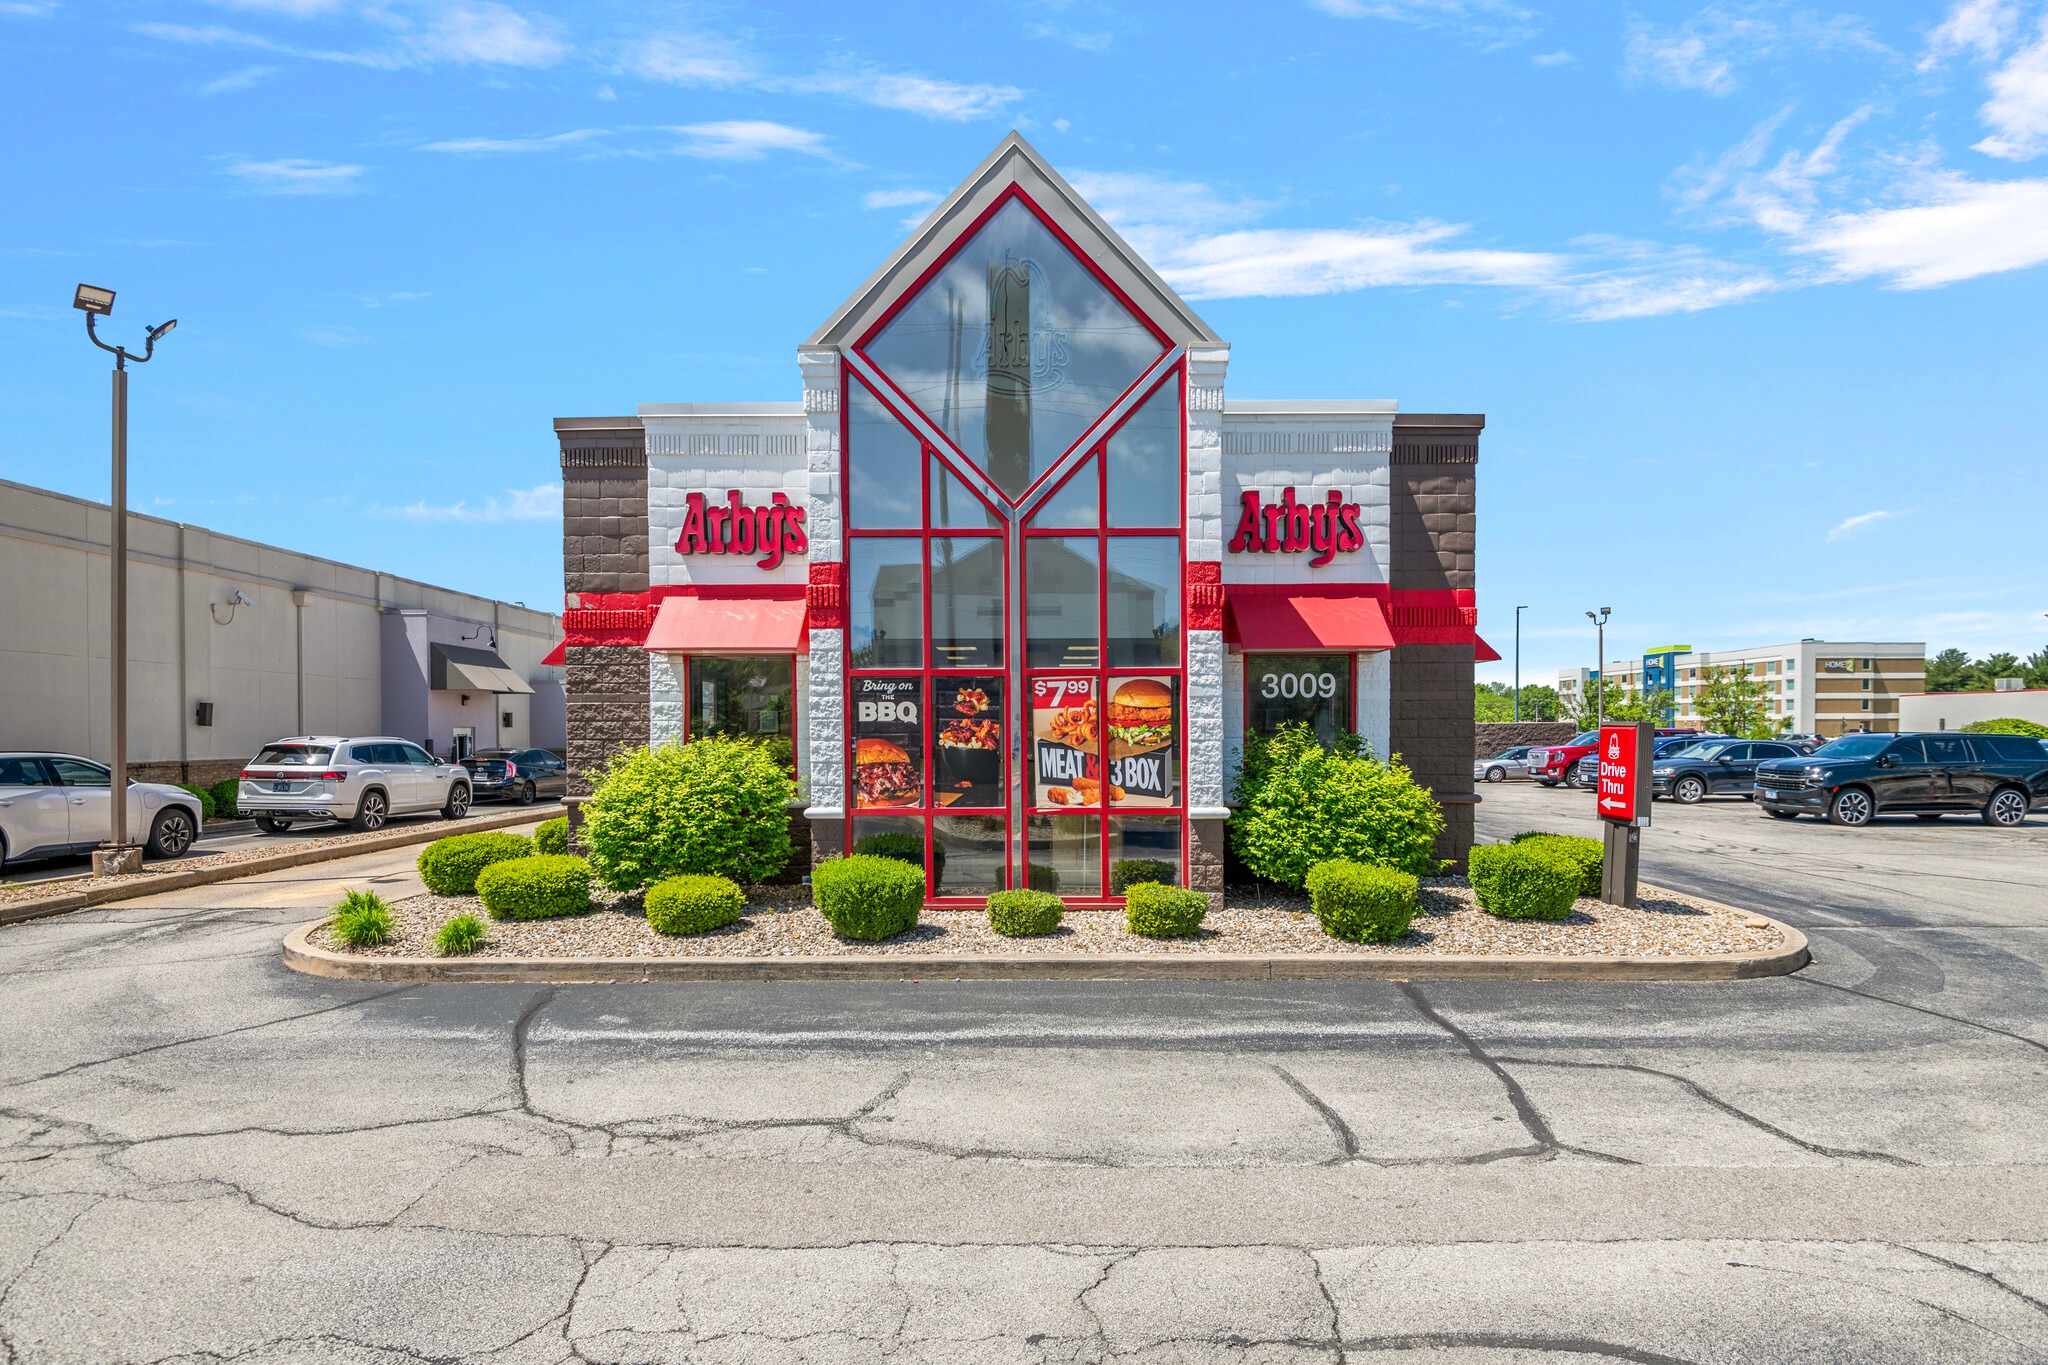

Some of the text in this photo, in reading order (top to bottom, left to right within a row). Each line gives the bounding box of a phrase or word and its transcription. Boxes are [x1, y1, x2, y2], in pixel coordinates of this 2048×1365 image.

[675, 489, 808, 570] Arby's
[1229, 487, 1364, 567] Arby's
[863, 680, 897, 694] Bring
[1261, 673, 1336, 699] 3009
[858, 701, 918, 725] BBQ
[1041, 748, 1162, 791] MEAT & 3 BOX
[1601, 762, 1626, 778] Drive
[1602, 779, 1624, 795] Thru
